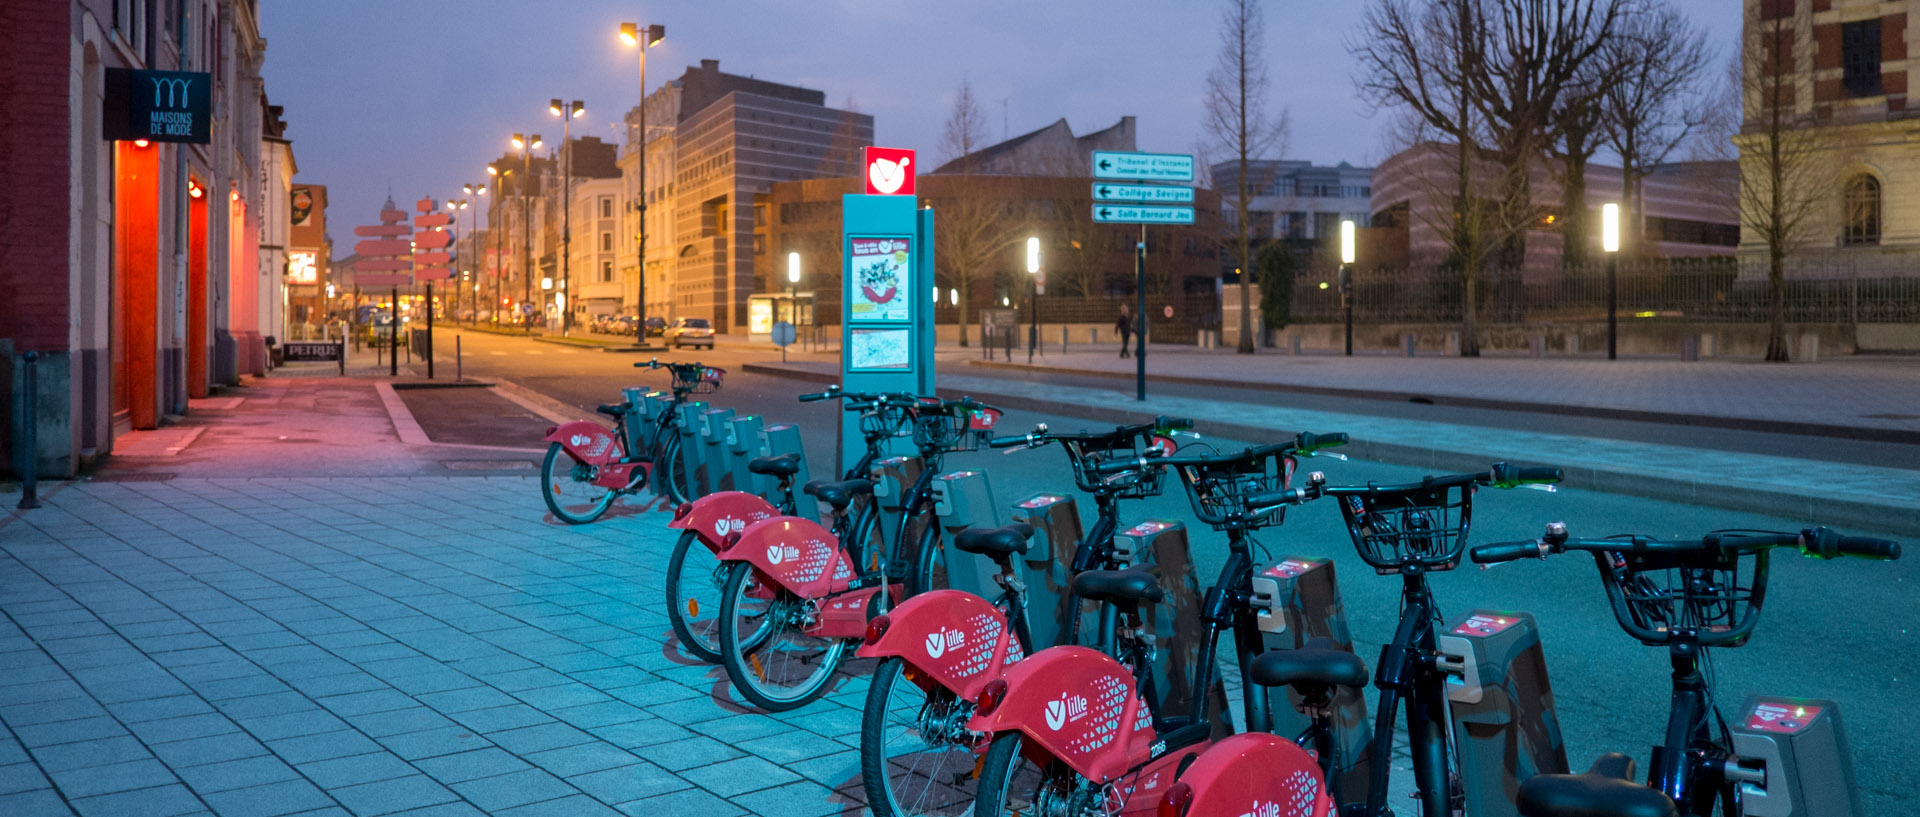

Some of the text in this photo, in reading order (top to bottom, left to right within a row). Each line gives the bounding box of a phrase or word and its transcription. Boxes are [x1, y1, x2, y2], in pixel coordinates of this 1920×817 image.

[150, 111, 193, 124] MAISONS
[150, 123, 192, 136] DE MODE
[1118, 157, 1148, 165] Tribunal
[1117, 209, 1138, 218] Salle
[1140, 210, 1172, 219] Bernard
[289, 344, 336, 357] PETRUS
[1150, 740, 1166, 759] 2266
